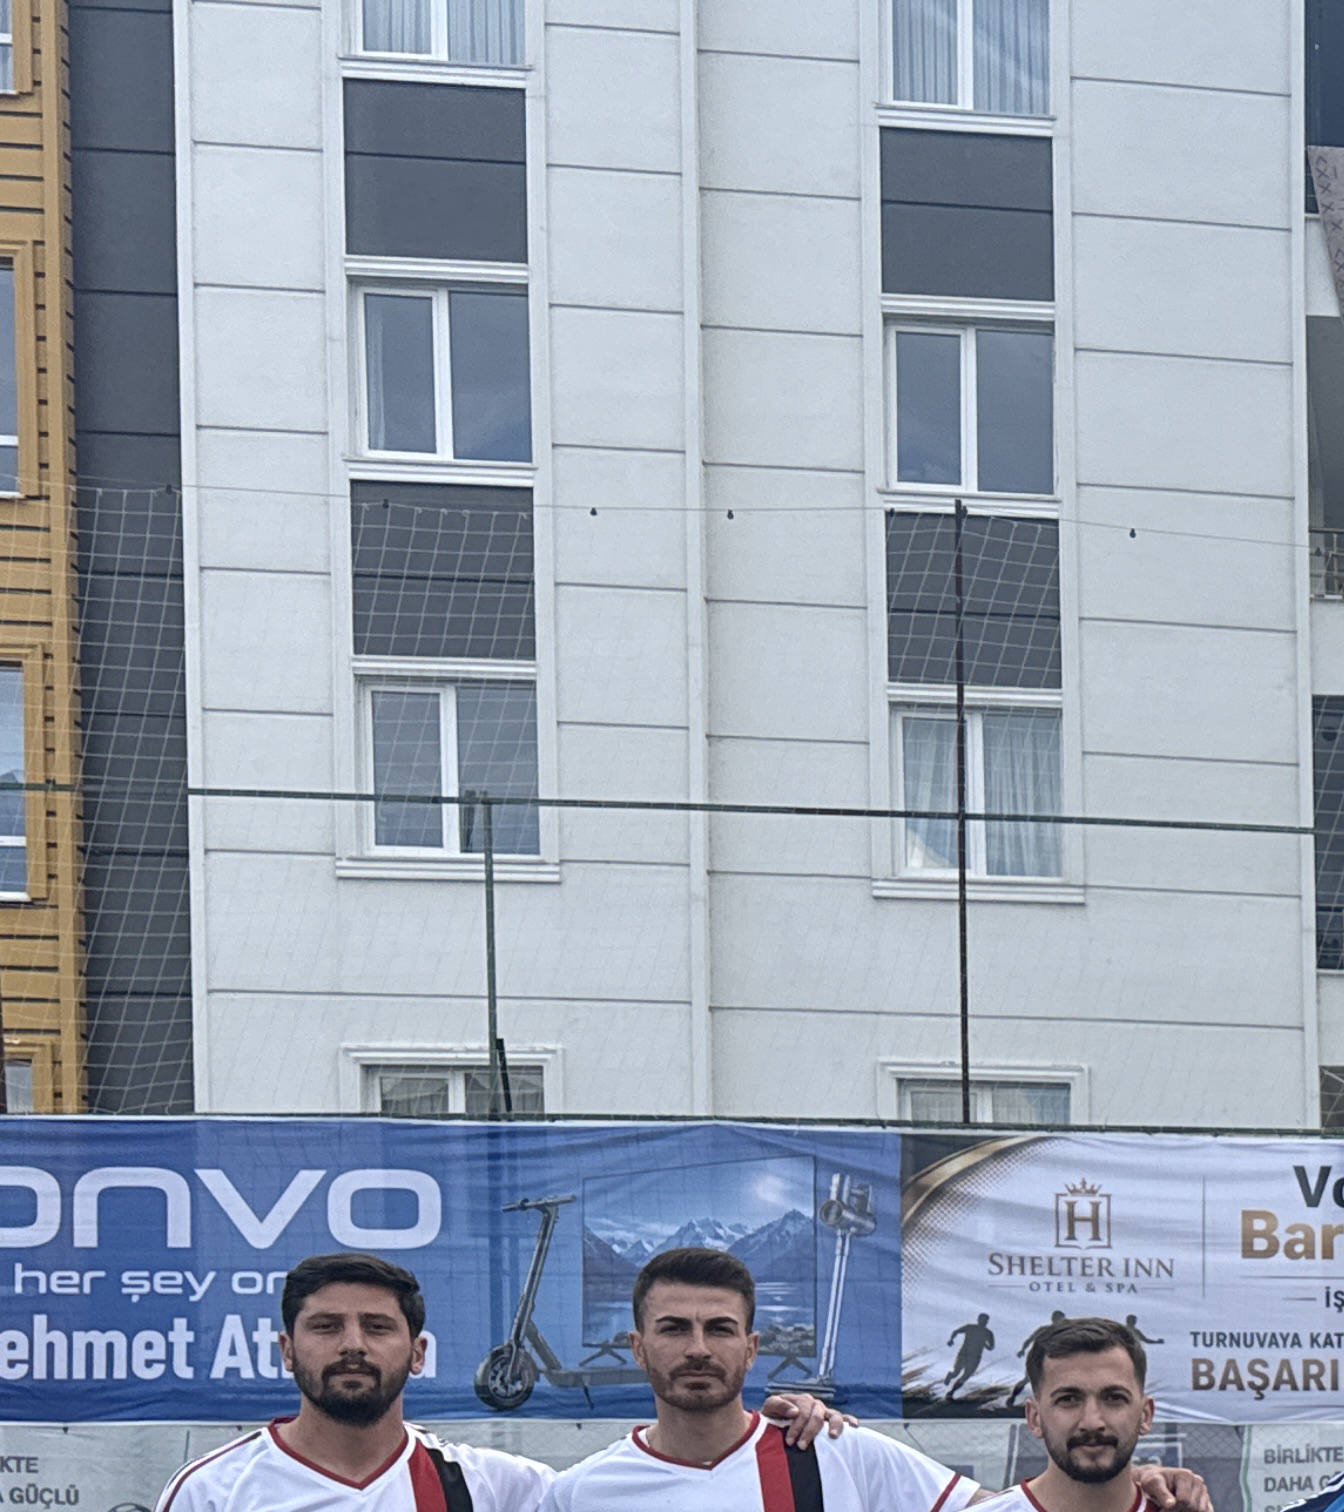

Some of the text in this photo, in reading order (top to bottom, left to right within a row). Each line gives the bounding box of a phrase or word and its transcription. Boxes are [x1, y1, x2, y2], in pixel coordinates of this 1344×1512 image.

[987, 1251, 1175, 1279] SHELTER INN
[14, 1263, 107, 1296] her
[120, 1268, 217, 1302] şey
[1028, 1281, 1140, 1295] OTEL & SPA
[0, 1313, 195, 1380] ehmet
[1190, 1331, 1303, 1349] TURNUVAYA
[1263, 1443, 1344, 1464] BİRLİKTE
[1263, 1475, 1315, 1493] DAHA
[9, 1483, 80, 1509] GÜÇLÜ
